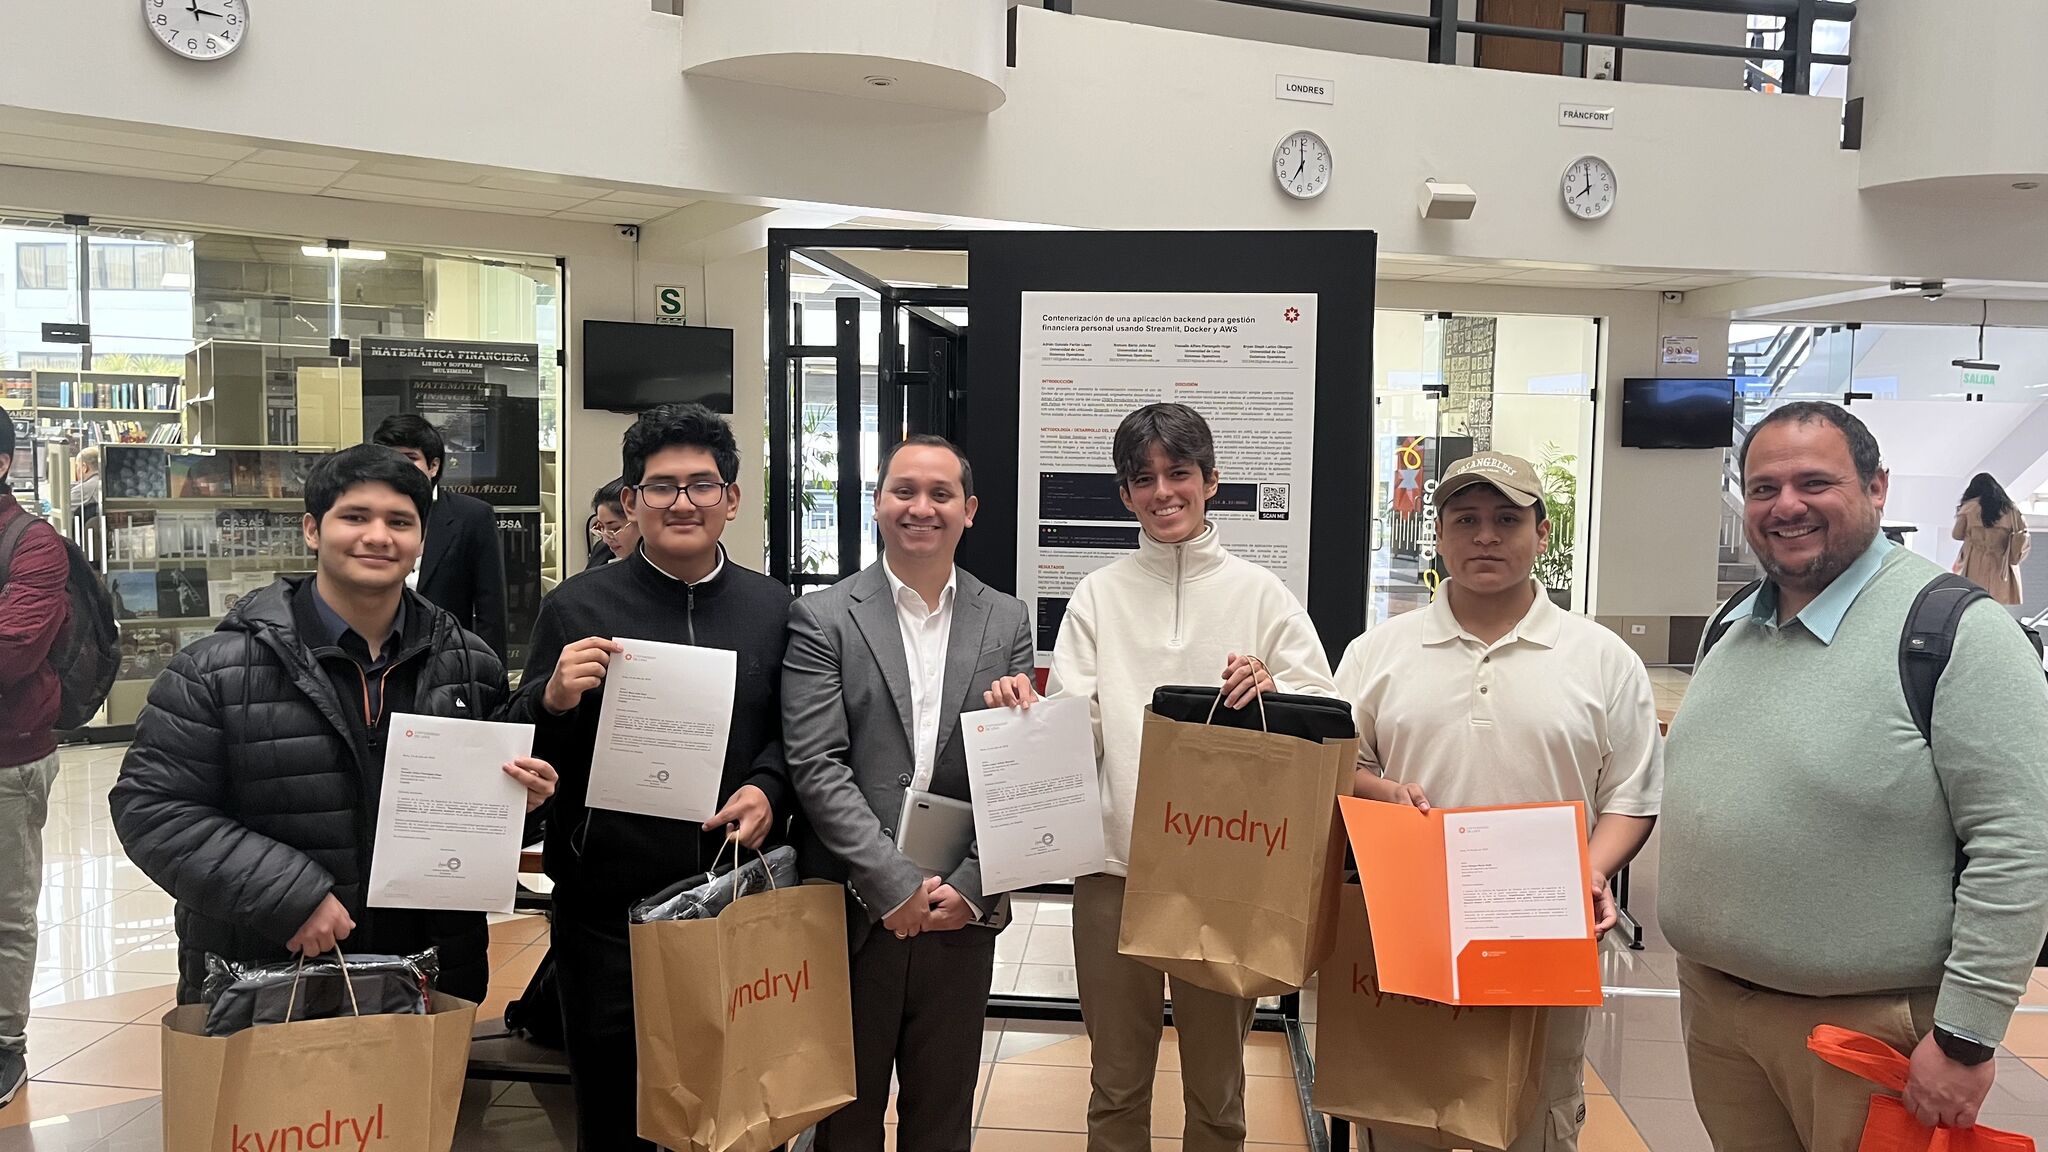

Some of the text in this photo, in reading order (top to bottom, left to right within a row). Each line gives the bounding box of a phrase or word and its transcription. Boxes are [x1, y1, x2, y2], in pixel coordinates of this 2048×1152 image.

[157, 14, 167, 25] 8
[227, 14, 236, 25] 3
[170, 29, 179, 40] 7
[221, 30, 230, 40] 4
[188, 38, 197, 49] 6
[206, 38, 216, 49] 5
[1286, 83, 1324, 95] LONDRES
[1563, 110, 1609, 121] FRÁNCFORT
[1317, 152, 1323, 160] 2
[1279, 158, 1285, 166] 9
[1318, 164, 1325, 173] 3
[1280, 170, 1287, 178] 8
[1600, 173, 1607, 181] 2
[1287, 180, 1293, 188] 7
[1296, 184, 1303, 192] 6
[1307, 183, 1313, 191] 5
[1566, 185, 1572, 193] 9
[1569, 196, 1575, 204] 8
[1576, 204, 1581, 212] 7
[1585, 206, 1591, 214] 6
[661, 289, 681, 314] S
[1042, 314, 1103, 322] Contenerización
[1132, 315, 1171, 323] aplicación
[1226, 316, 1256, 325] gestión
[1146, 325, 1182, 333] Streamlit,
[371, 346, 530, 362] MATEMÁTICA FINANCIERA
[1963, 373, 1995, 385] SALIDA
[222, 518, 265, 527] CASAS
[1164, 801, 1288, 857] kyndryl
[728, 959, 809, 1022] yndryl
[232, 1103, 383, 1152] kyndryl
